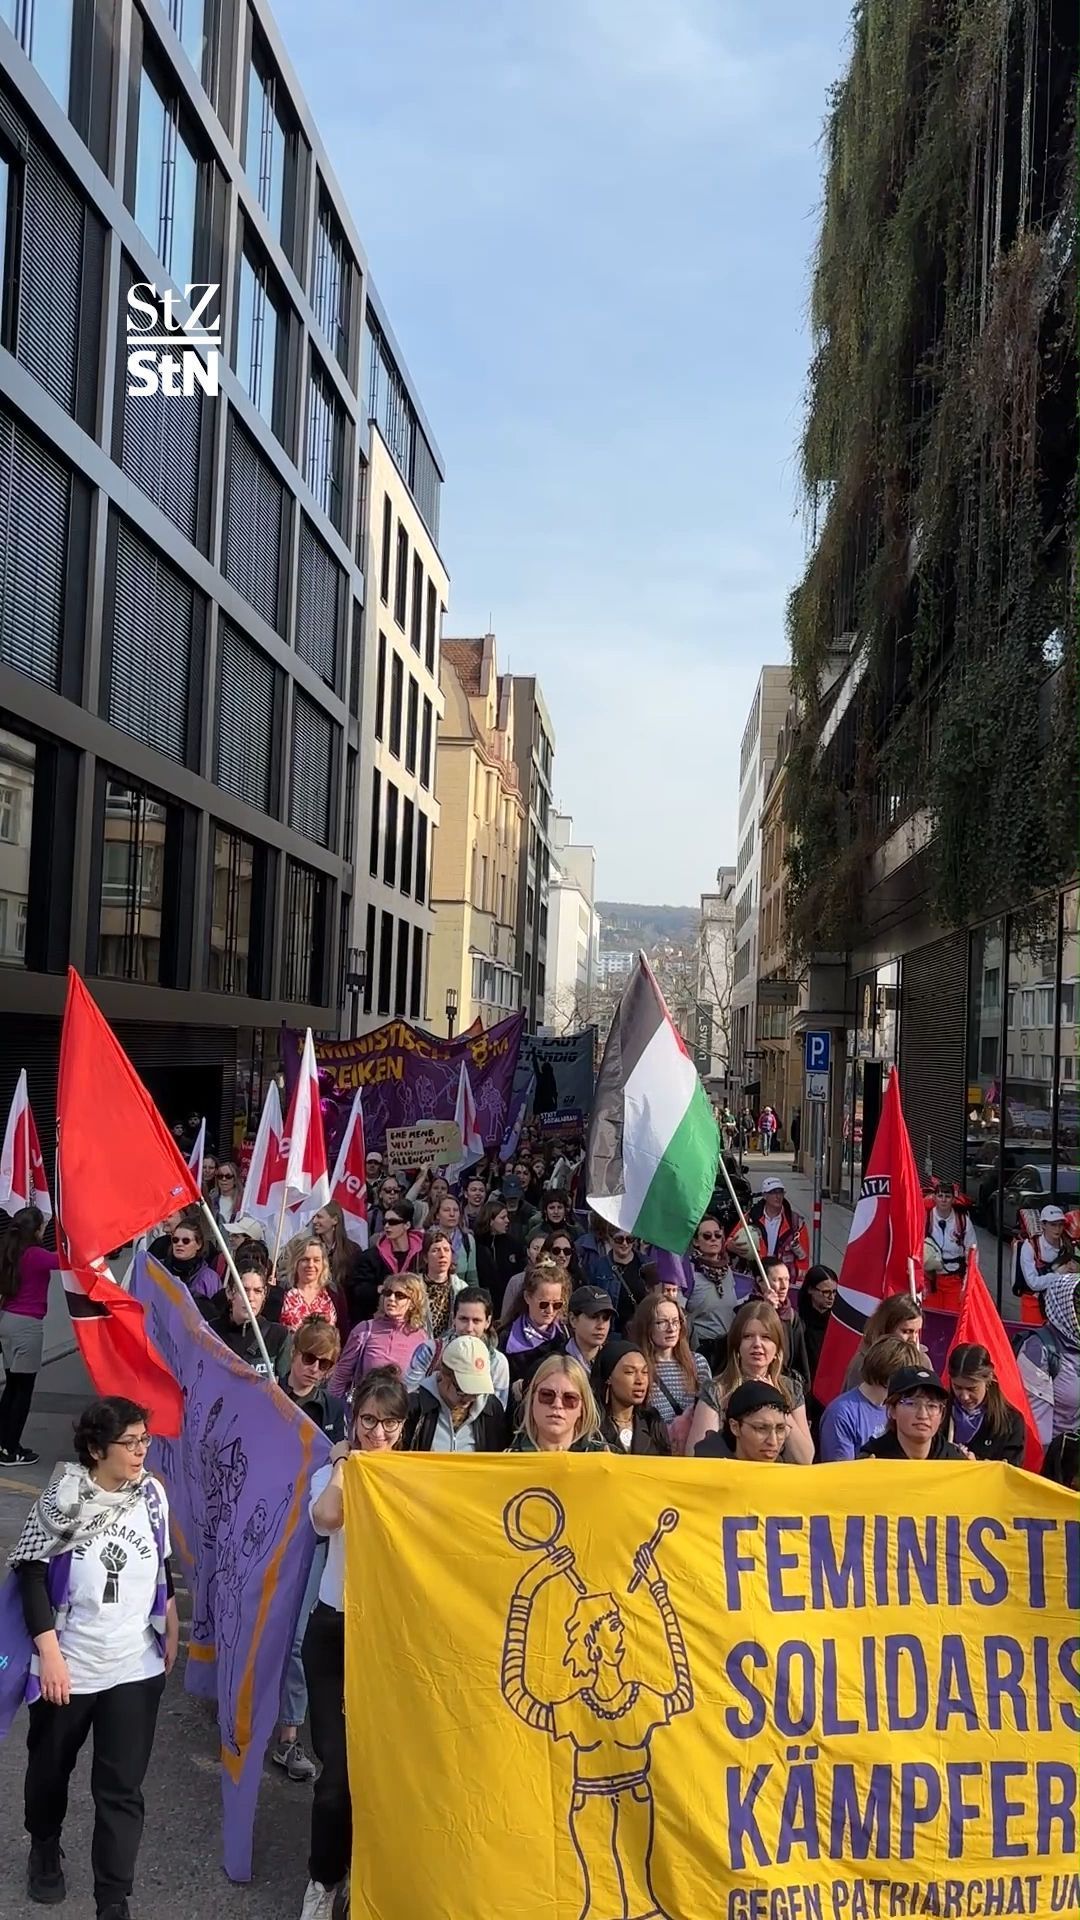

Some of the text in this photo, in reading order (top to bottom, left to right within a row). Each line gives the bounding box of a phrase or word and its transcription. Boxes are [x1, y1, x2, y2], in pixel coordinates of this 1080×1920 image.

[811, 1037, 824, 1066] P
[722, 1515, 1080, 1612] FEMINISTI
[726, 1744, 1077, 1870] KÄMPFER
[728, 1883, 821, 1920] GEGEN
[832, 1875, 1042, 1919] PATRIARCHAT
